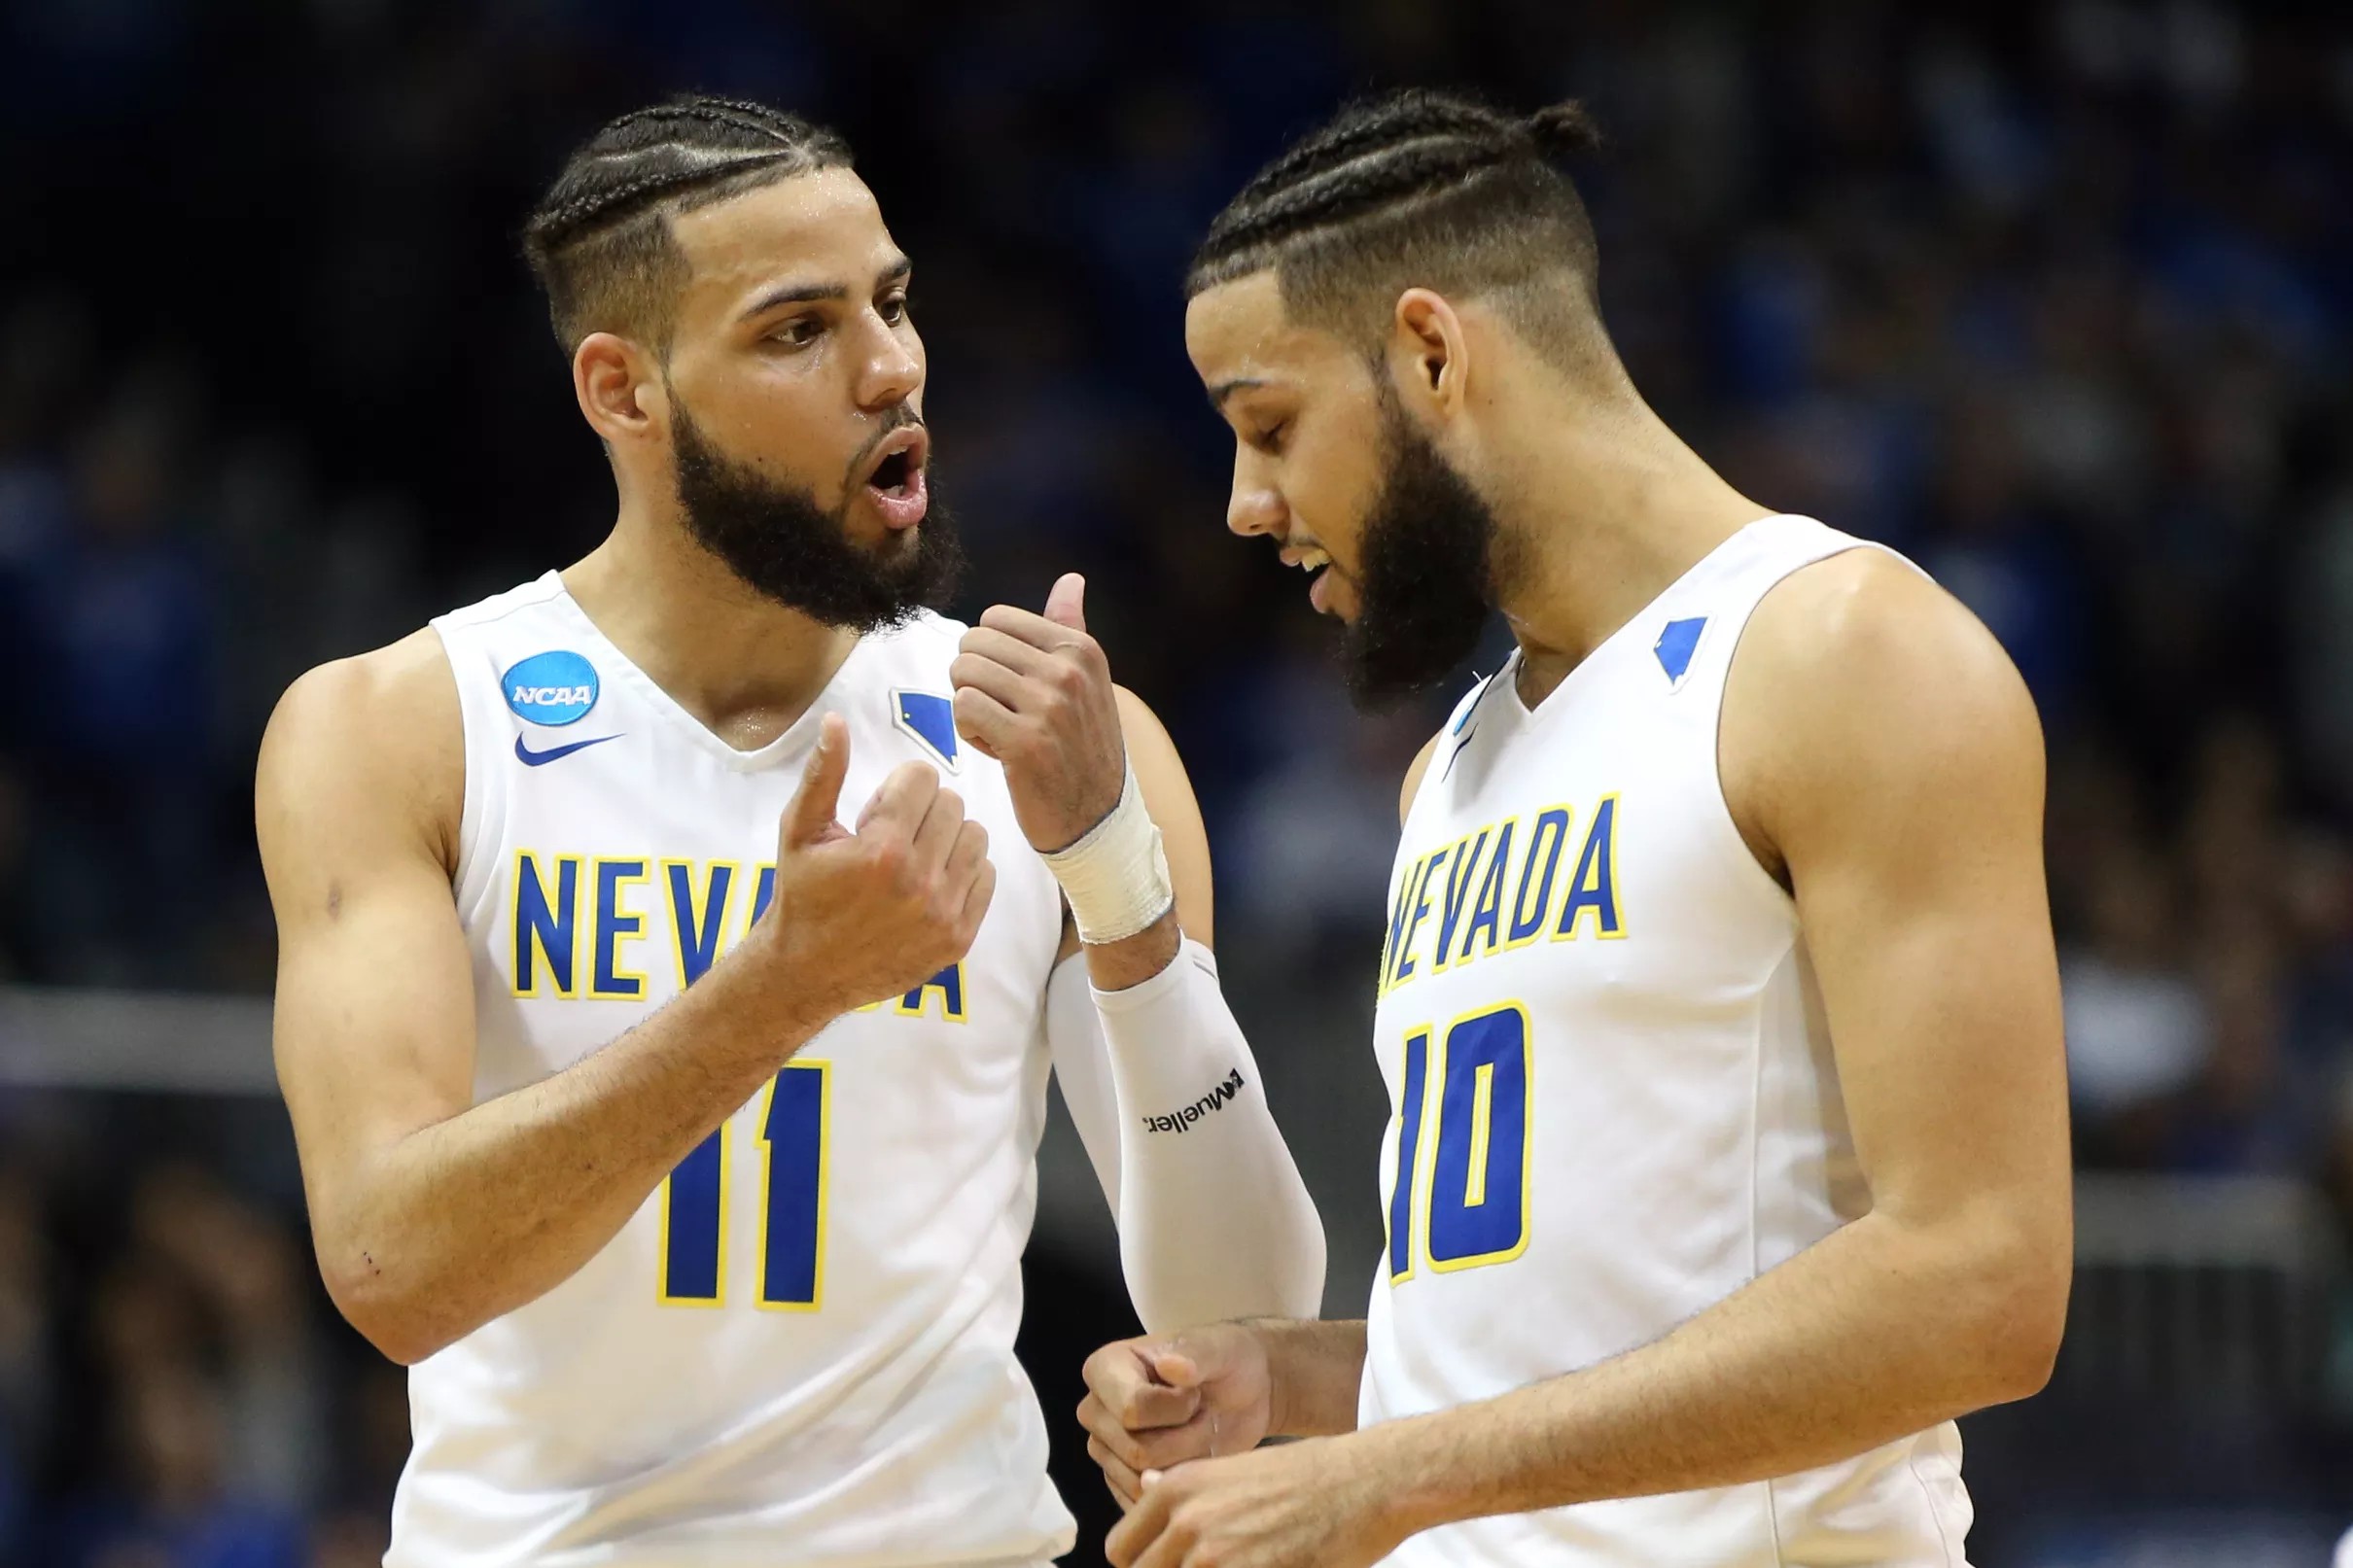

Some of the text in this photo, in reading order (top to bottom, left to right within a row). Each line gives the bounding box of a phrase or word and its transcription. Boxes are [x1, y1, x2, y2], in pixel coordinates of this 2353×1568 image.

[512, 685, 591, 706] NCAA
[511, 849, 968, 1025] NEV
[1378, 790, 1628, 997] NEVADA
[656, 1058, 832, 1312] 11
[1144, 1080, 1236, 1134] Mueller
[1388, 998, 1533, 1288] 10
